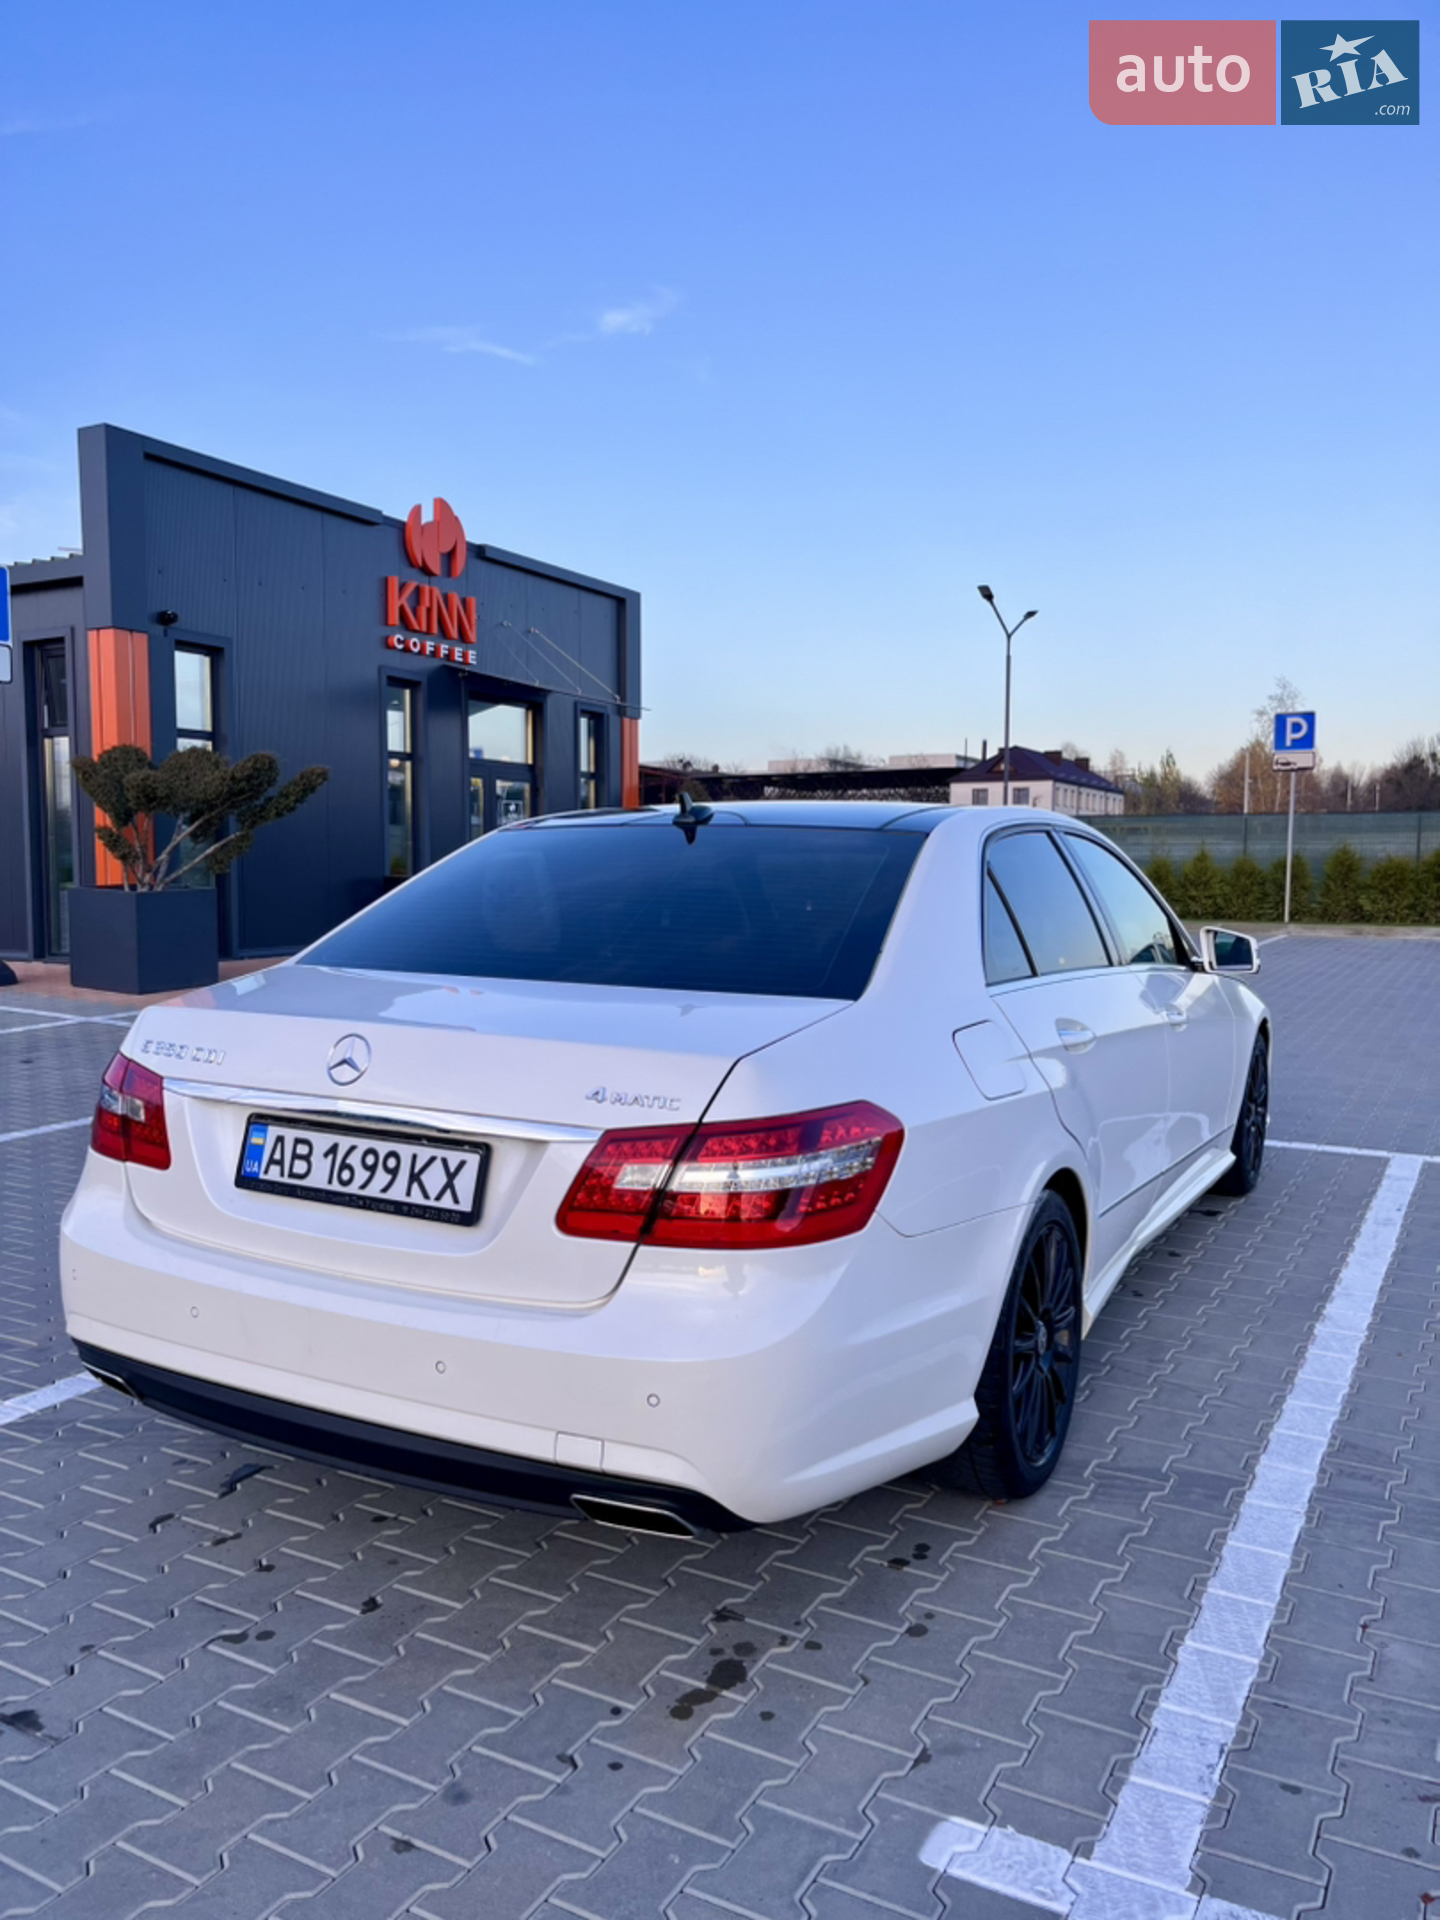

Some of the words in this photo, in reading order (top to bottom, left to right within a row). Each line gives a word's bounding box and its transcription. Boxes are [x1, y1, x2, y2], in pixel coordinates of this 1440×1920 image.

[386, 575, 477, 644] KINN
[388, 633, 477, 666] COFFEE
[1286, 717, 1308, 747] P
[245, 1159, 259, 1173] UA
[263, 1135, 314, 1180] AB
[323, 1142, 402, 1194] 1699
[405, 1153, 467, 1205] KX
